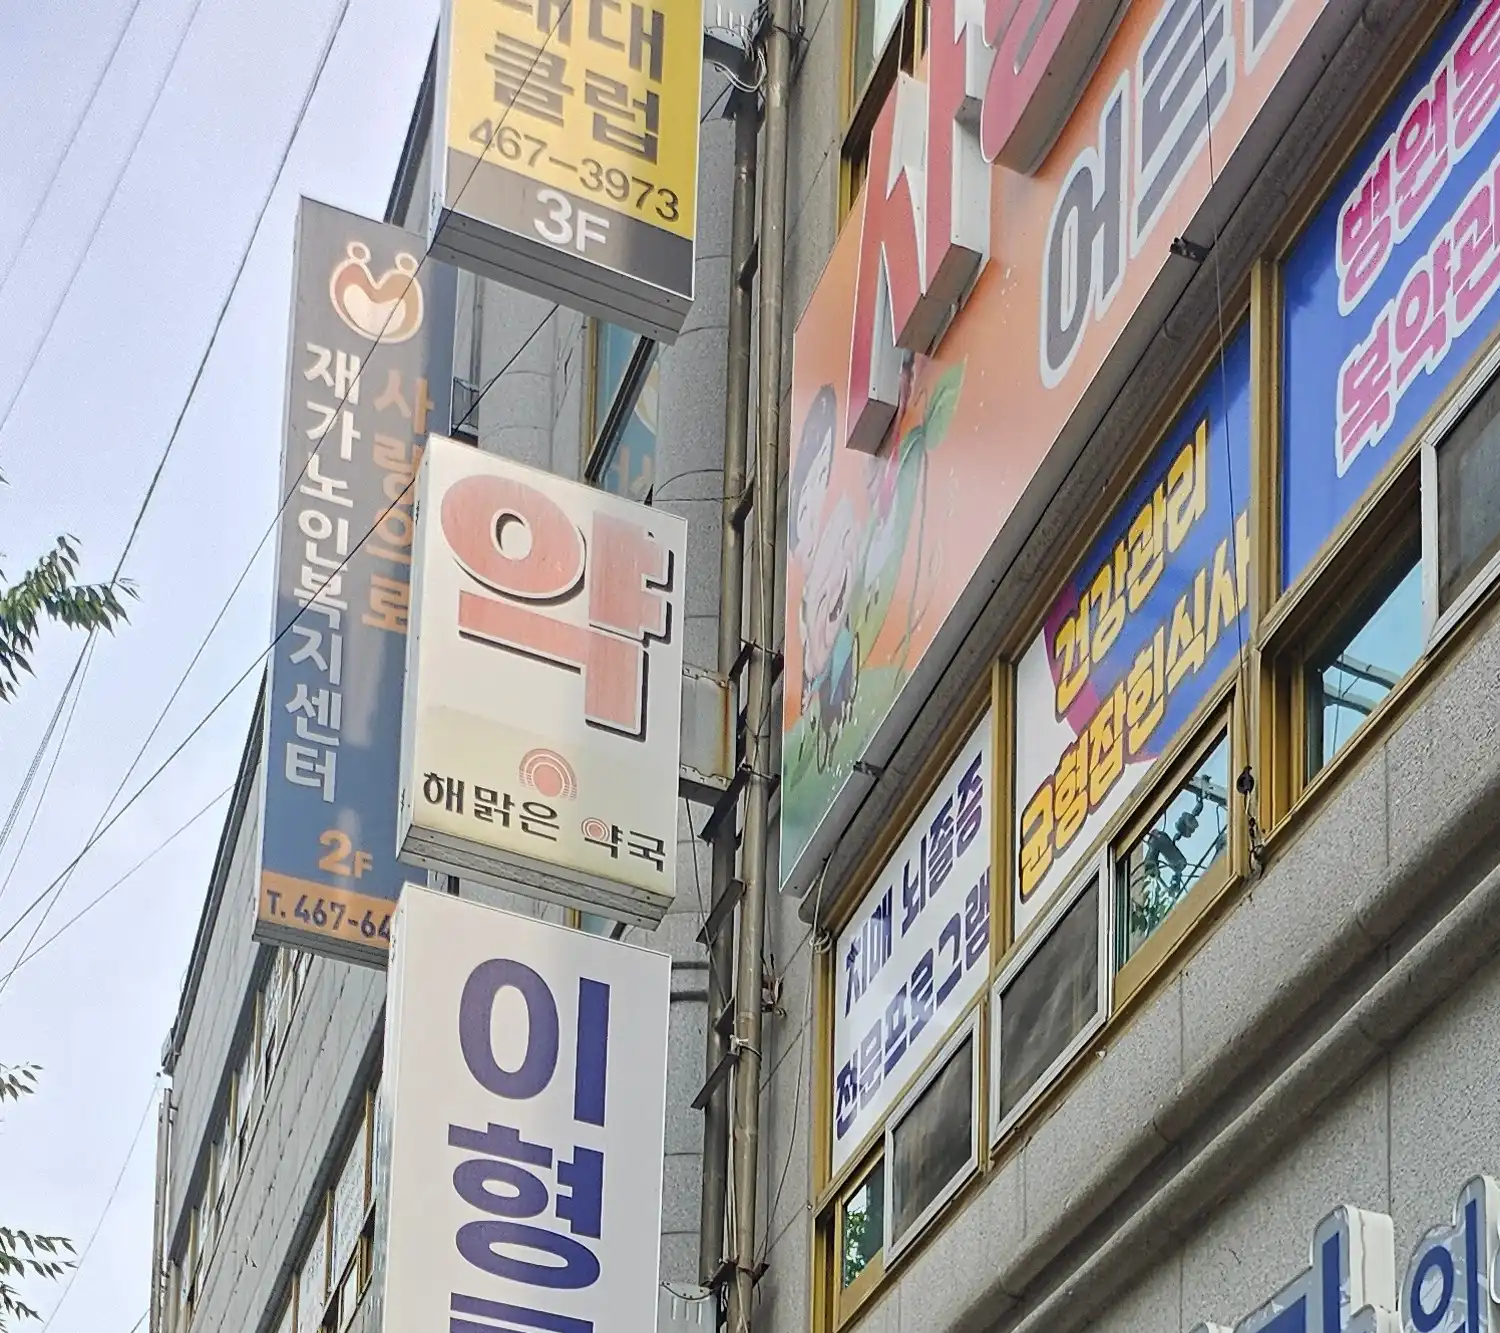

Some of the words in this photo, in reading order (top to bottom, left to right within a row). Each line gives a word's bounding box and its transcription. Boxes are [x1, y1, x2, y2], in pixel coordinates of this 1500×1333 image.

[485, 31, 660, 165] 클럽
[492, 0, 664, 84] 대
[469, 118, 680, 222] 467-3973
[533, 189, 610, 252] 3F
[285, 342, 361, 803] 재가노인복지센터
[440, 474, 673, 742] 약
[1055, 421, 1209, 723] 건강관리
[318, 829, 374, 879] 2F
[844, 885, 894, 1018] 치매
[902, 751, 984, 938] 뇌졸중
